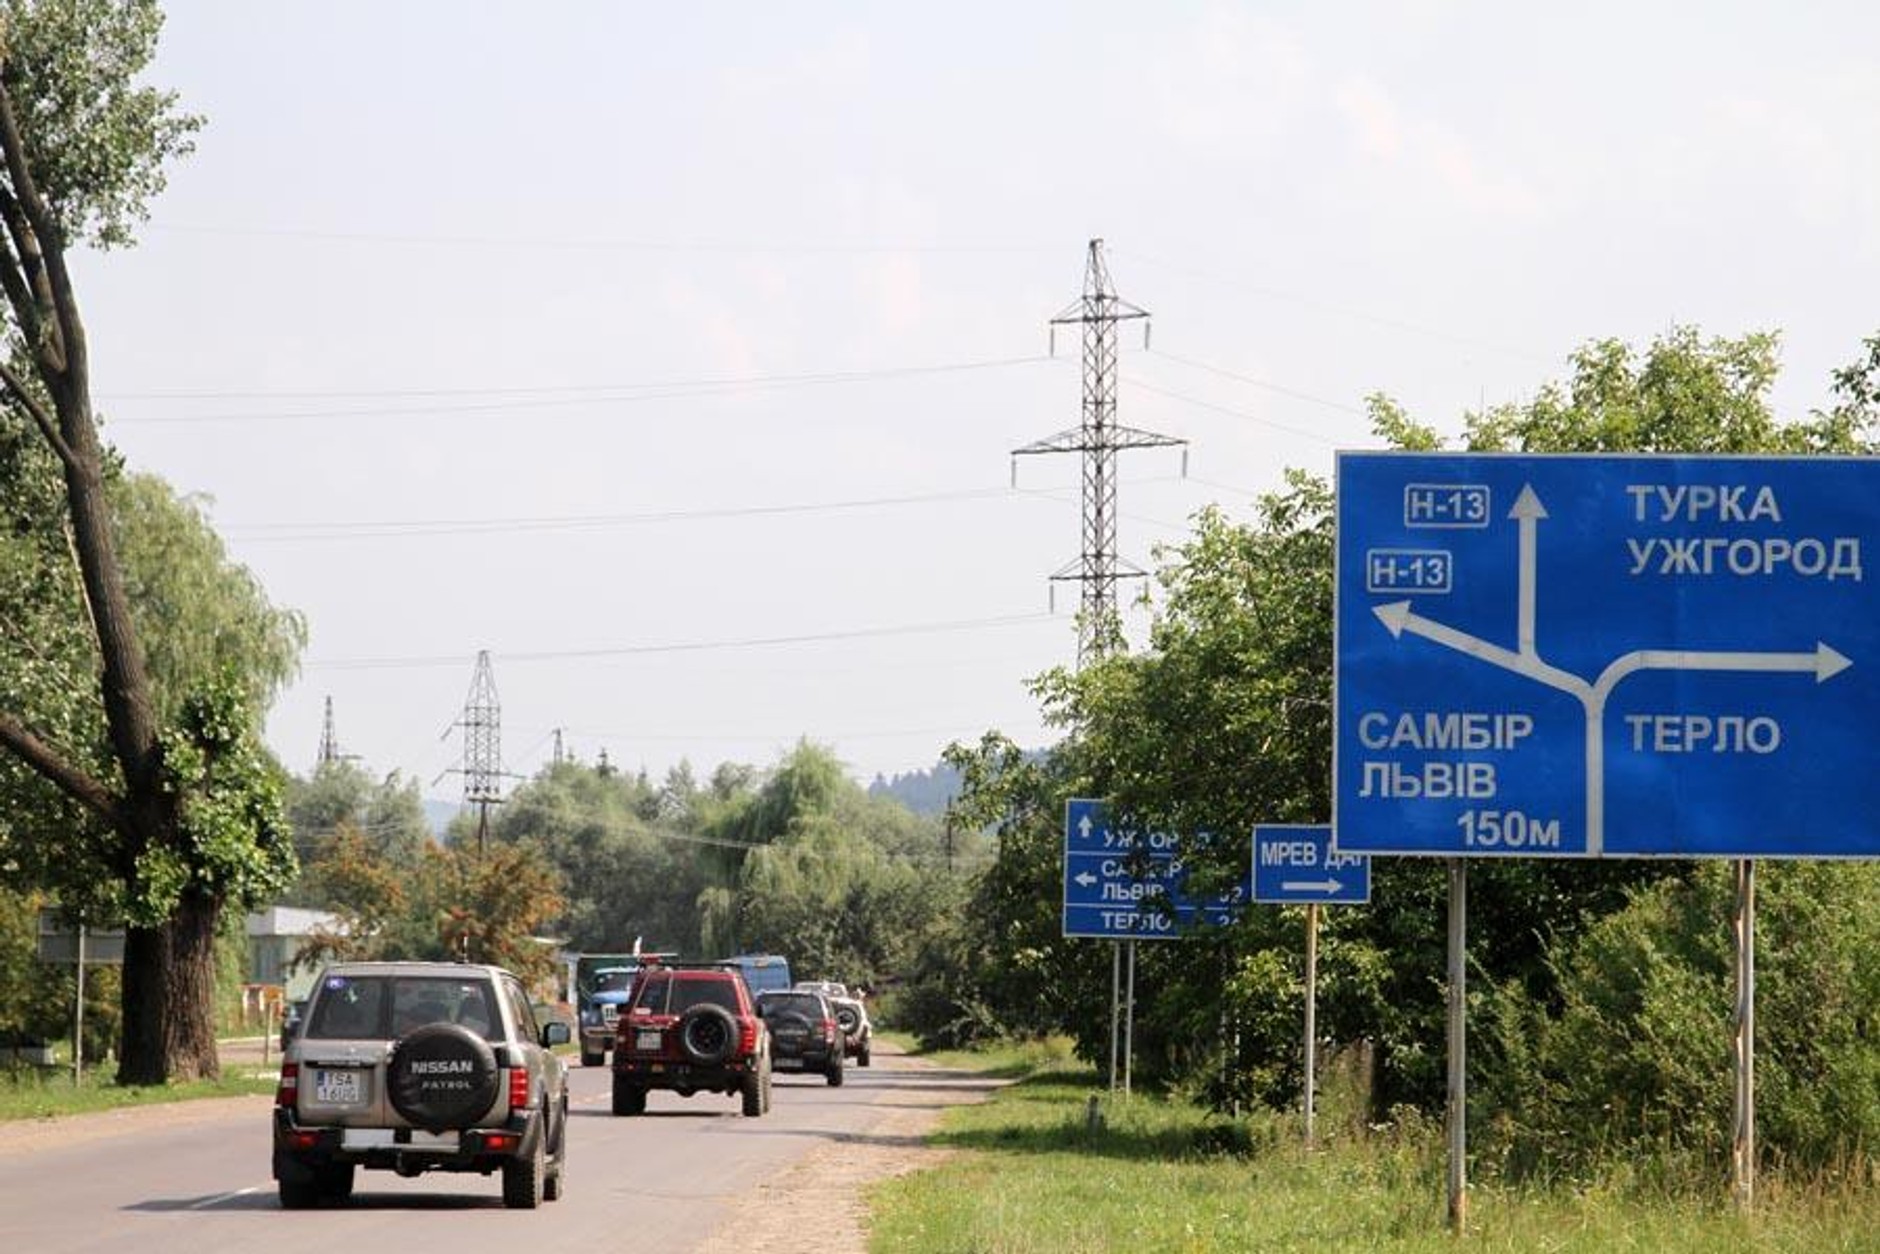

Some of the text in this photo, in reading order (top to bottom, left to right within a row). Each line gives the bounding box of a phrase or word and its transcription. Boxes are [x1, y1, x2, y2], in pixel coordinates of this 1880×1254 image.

[1411, 491, 1485, 520] Н-13
[1626, 484, 1782, 522] ТУРКА
[1374, 557, 1445, 586] Н-13
[1627, 537, 1863, 582] УЖГОРОД
[1358, 712, 1534, 750] САМБІР
[1623, 714, 1781, 754] ТЕРЛО
[1359, 761, 1497, 798] ЛЬВІВ
[1457, 809, 1560, 847] 150м
[1261, 841, 1318, 867] МРЕВ
[411, 1060, 474, 1074] NISSAN
[421, 1080, 472, 1090] PATROL
